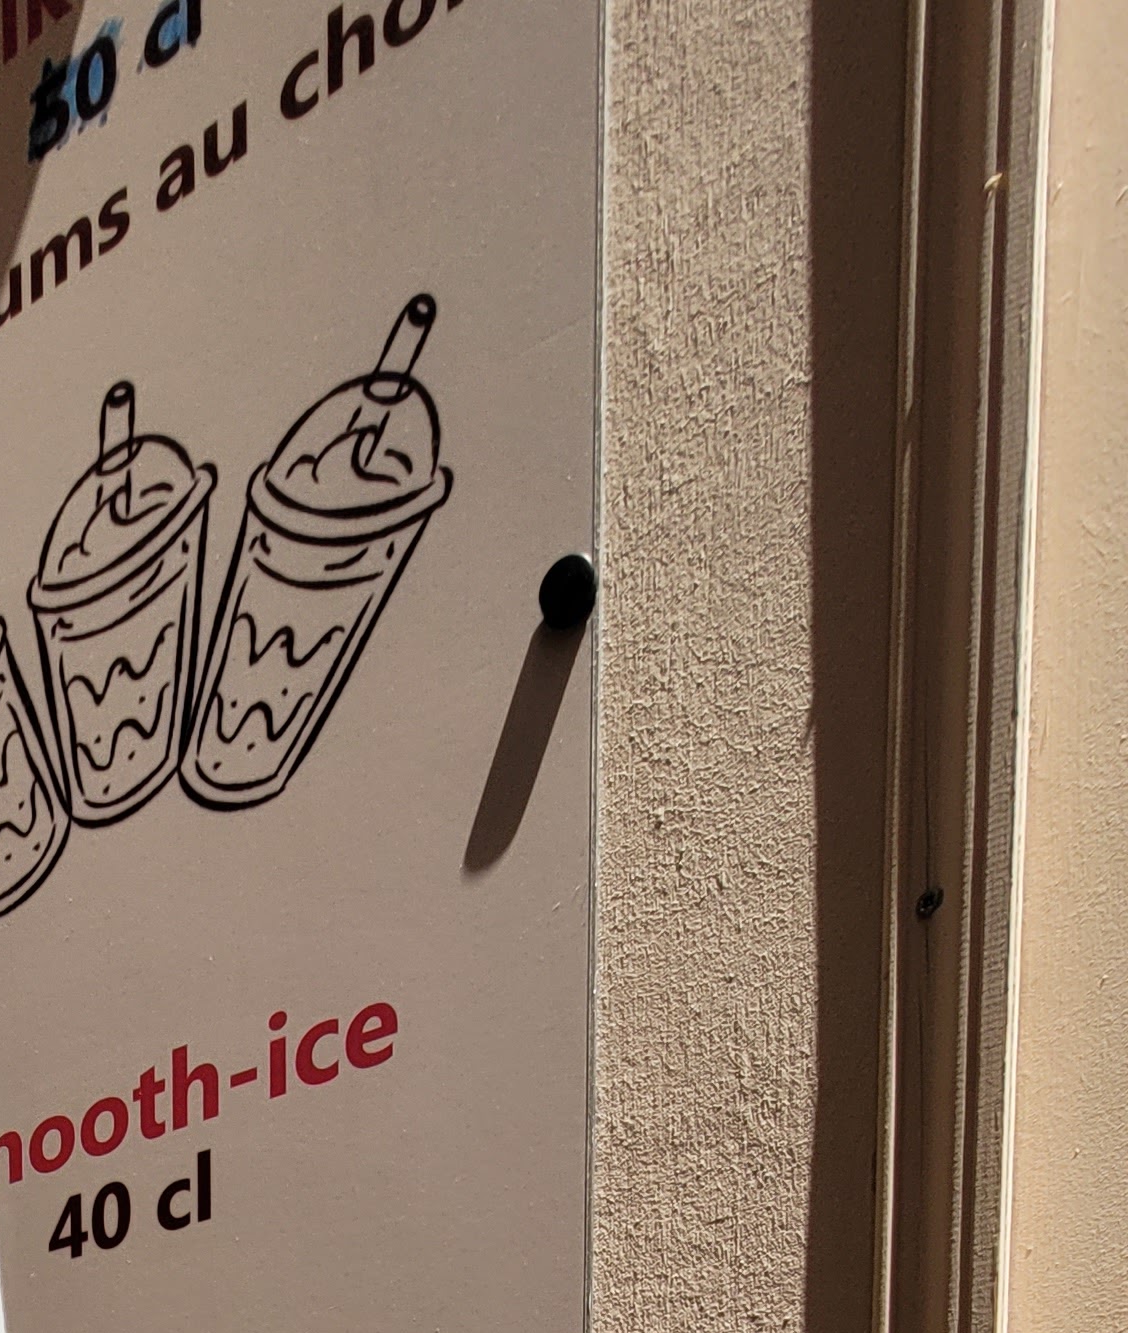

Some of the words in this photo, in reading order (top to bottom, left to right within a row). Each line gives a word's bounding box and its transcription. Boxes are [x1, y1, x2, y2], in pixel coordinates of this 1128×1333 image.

[156, 100, 249, 213] au
[280, 0, 465, 121] cho
[48, 1181, 132, 1259] 40
[156, 1148, 212, 1231] cl
